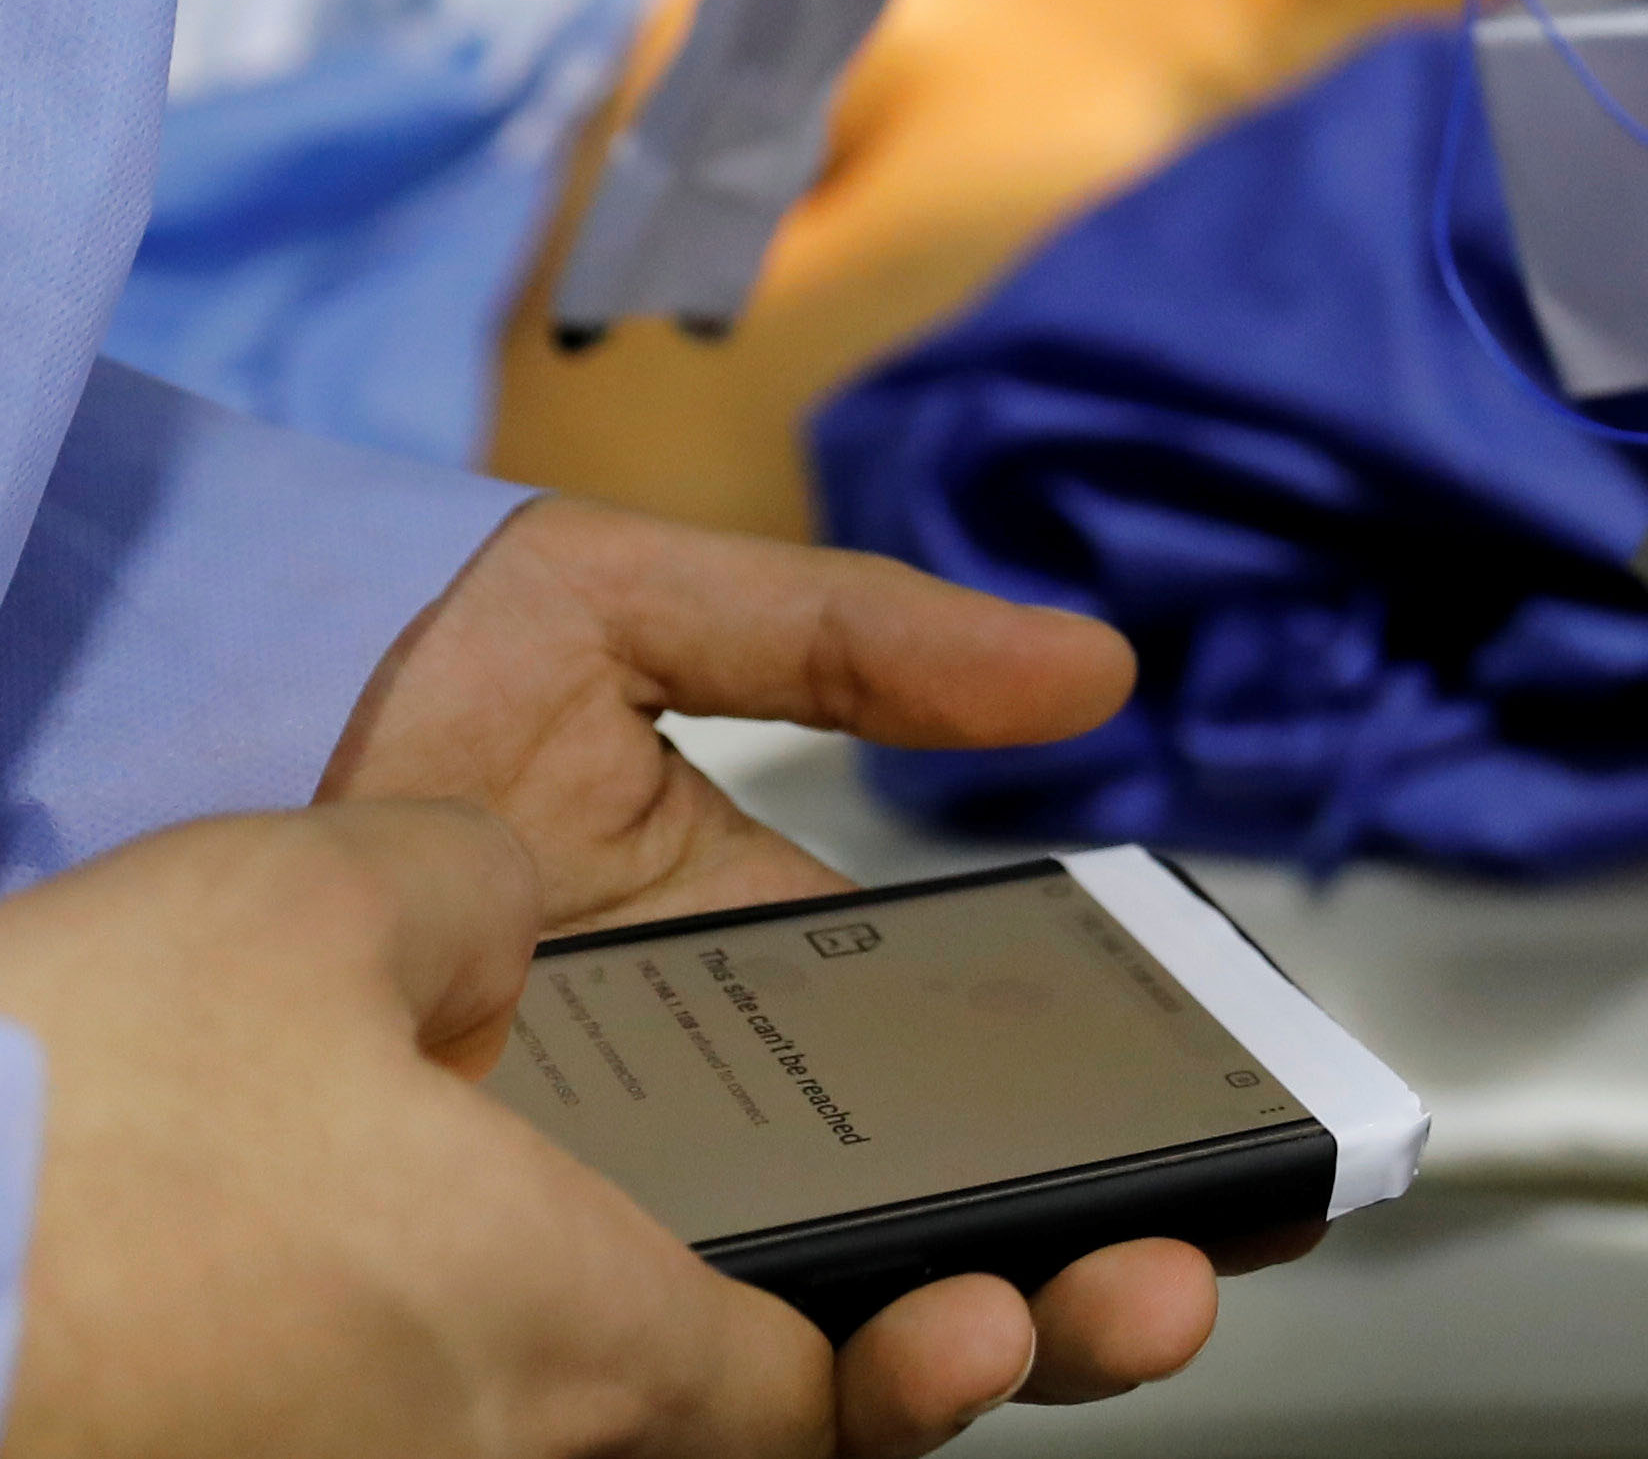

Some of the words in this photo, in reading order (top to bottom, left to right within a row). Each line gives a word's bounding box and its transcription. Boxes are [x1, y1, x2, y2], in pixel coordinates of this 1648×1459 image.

[699, 947, 734, 982] This
[723, 983, 760, 1013] site
[747, 1013, 796, 1054] can't
[778, 1052, 808, 1077] be
[796, 1077, 871, 1146] reached
